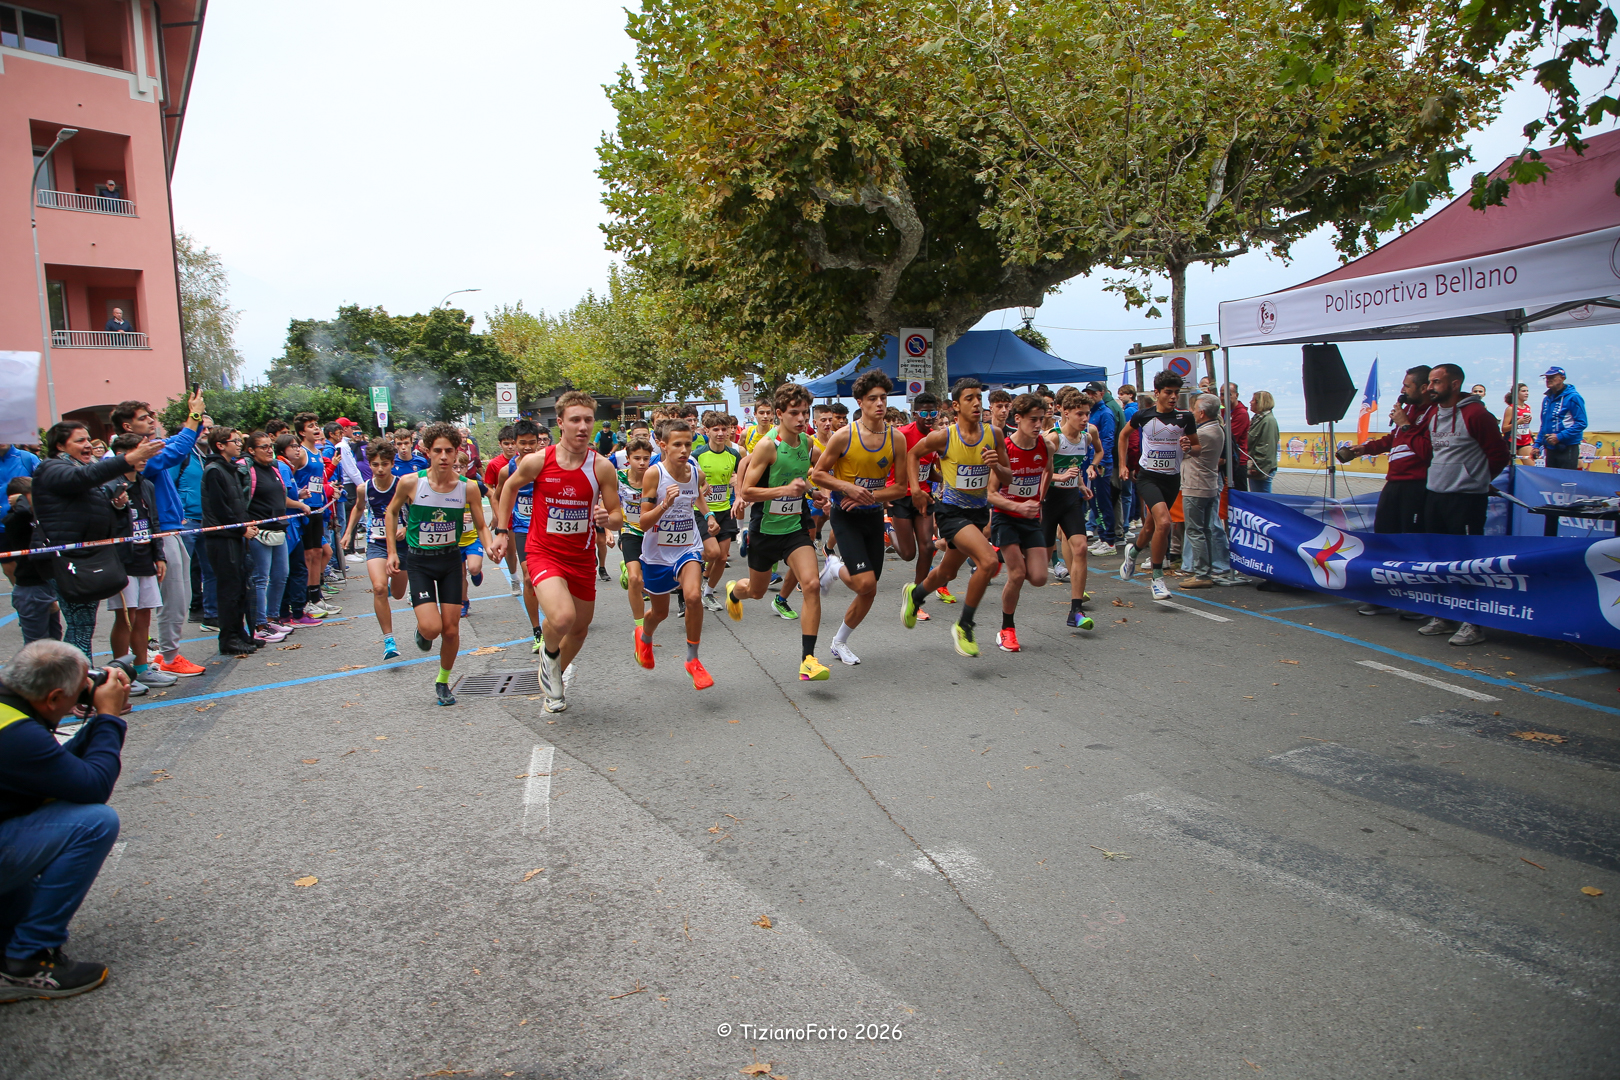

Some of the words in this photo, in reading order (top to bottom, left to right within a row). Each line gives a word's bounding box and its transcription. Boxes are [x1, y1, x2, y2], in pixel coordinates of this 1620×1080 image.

[1325, 281, 1427, 314] Polisportiva
[1435, 265, 1517, 296] Bellano
[964, 477, 983, 487] 161
[1019, 487, 1031, 495] 80
[781, 502, 794, 512] 64
[556, 521, 578, 532] 334
[1227, 506, 1281, 536] SPORT
[427, 534, 448, 543] 371
[666, 532, 687, 543] 249
[1371, 567, 1529, 592] SPECIALIST
